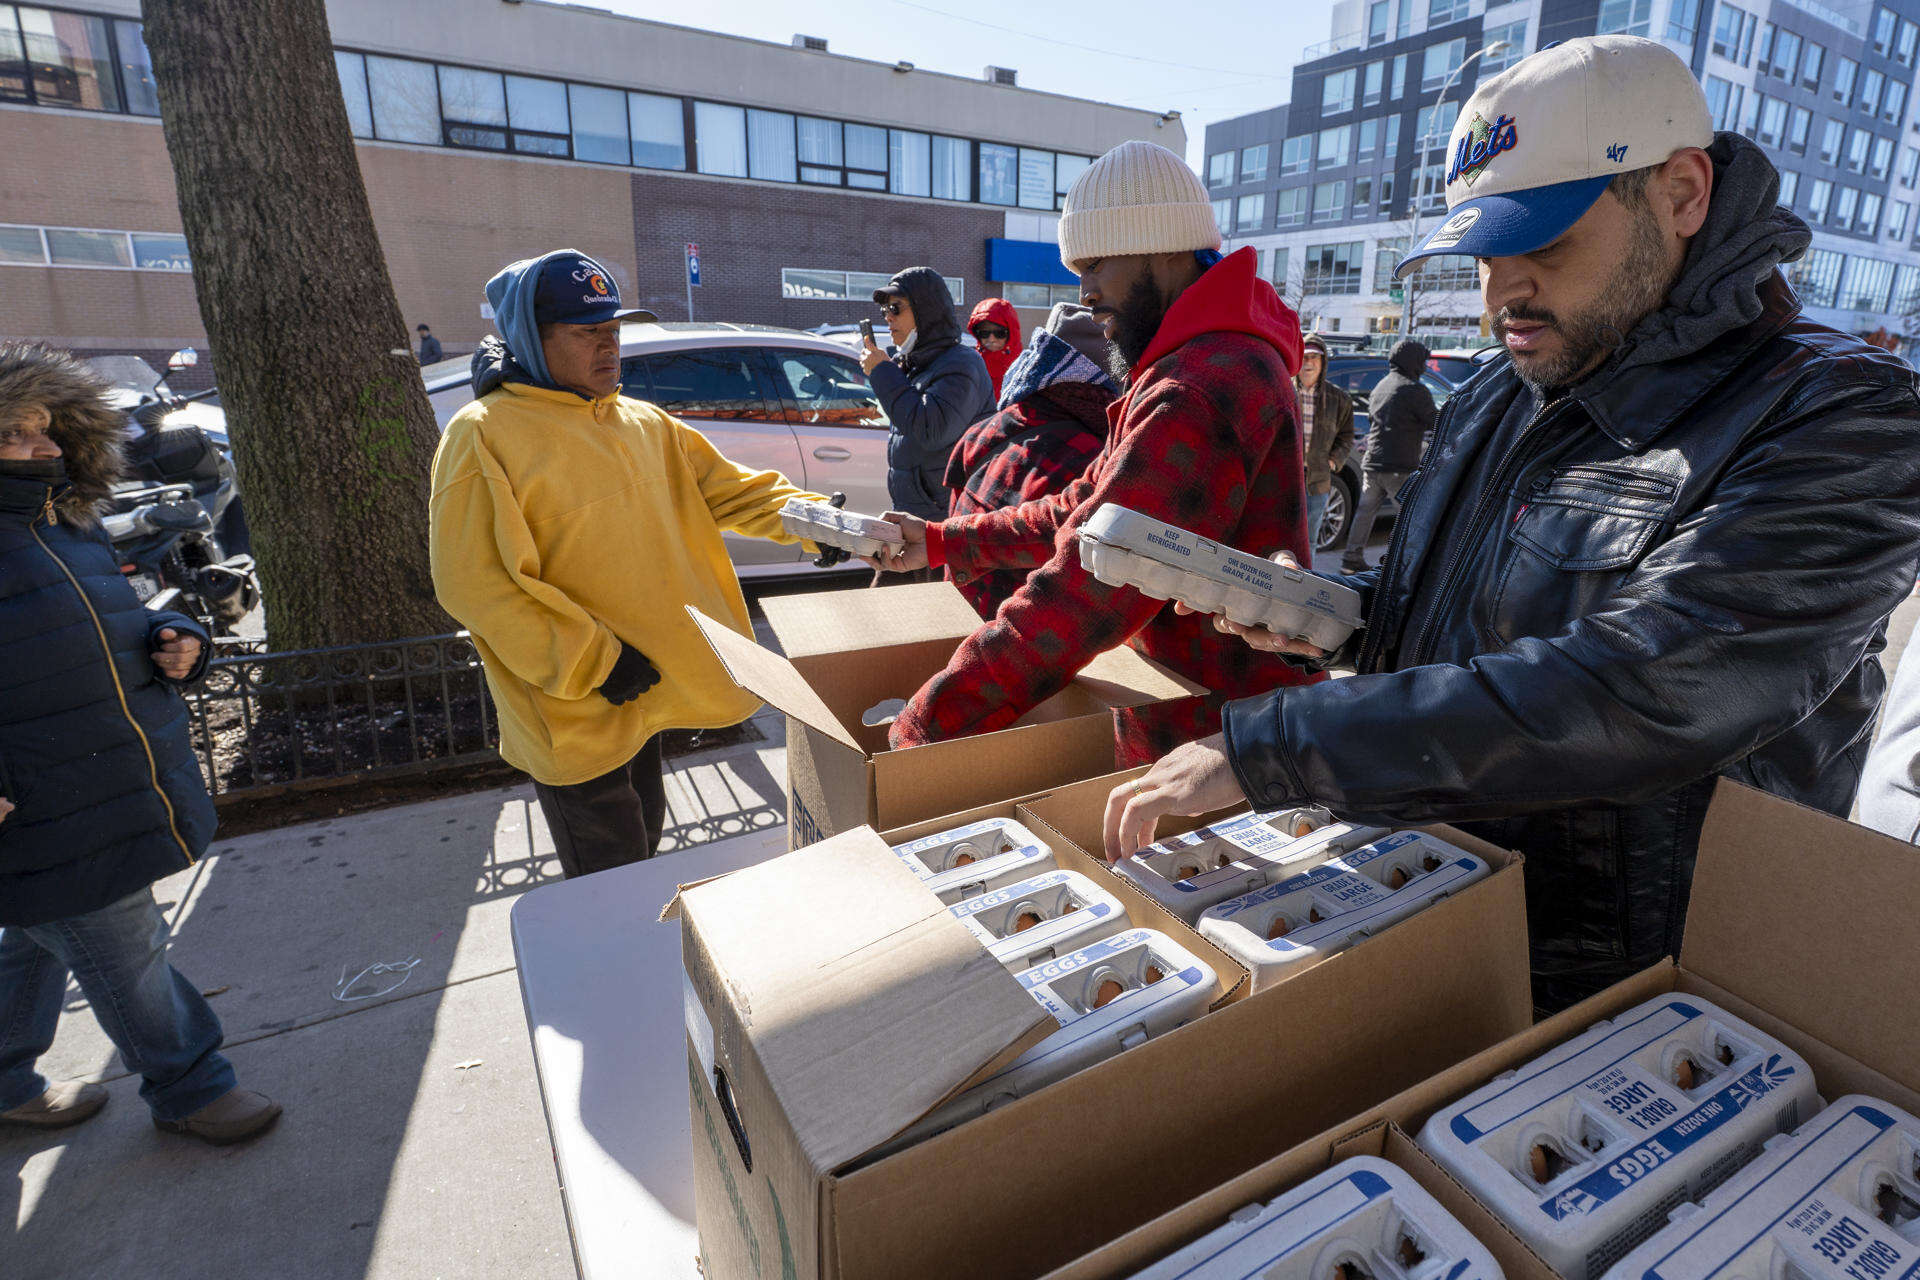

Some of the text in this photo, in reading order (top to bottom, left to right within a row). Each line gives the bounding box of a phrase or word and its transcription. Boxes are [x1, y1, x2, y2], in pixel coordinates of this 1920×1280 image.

[1446, 113, 1518, 186] Mets
[1147, 533, 1190, 556] REFRIGERATED
[1164, 529, 1180, 540] KEEP
[1222, 565, 1244, 579] GRADE
[1252, 577, 1272, 591] LARGE
[1228, 558, 1272, 581] ONE DOZEN EGGS
[901, 833, 952, 854] EGGS
[1231, 829, 1259, 840] GRADE
[1241, 832, 1278, 848] LARGE
[1322, 877, 1352, 893] GRADE
[1333, 882, 1373, 901] LARGE
[955, 890, 1011, 916] EGGS
[1027, 952, 1089, 985] EGGS
[1603, 1080, 1656, 1115] LARGE
[1627, 1098, 1678, 1130] GRADE A
[1701, 1101, 1723, 1118] ONE
[1673, 1113, 1707, 1136] DOZEN
[1608, 1140, 1674, 1188] EGGS
[1812, 1216, 1870, 1265] LARGE
[1853, 1239, 1901, 1280] GRADE
